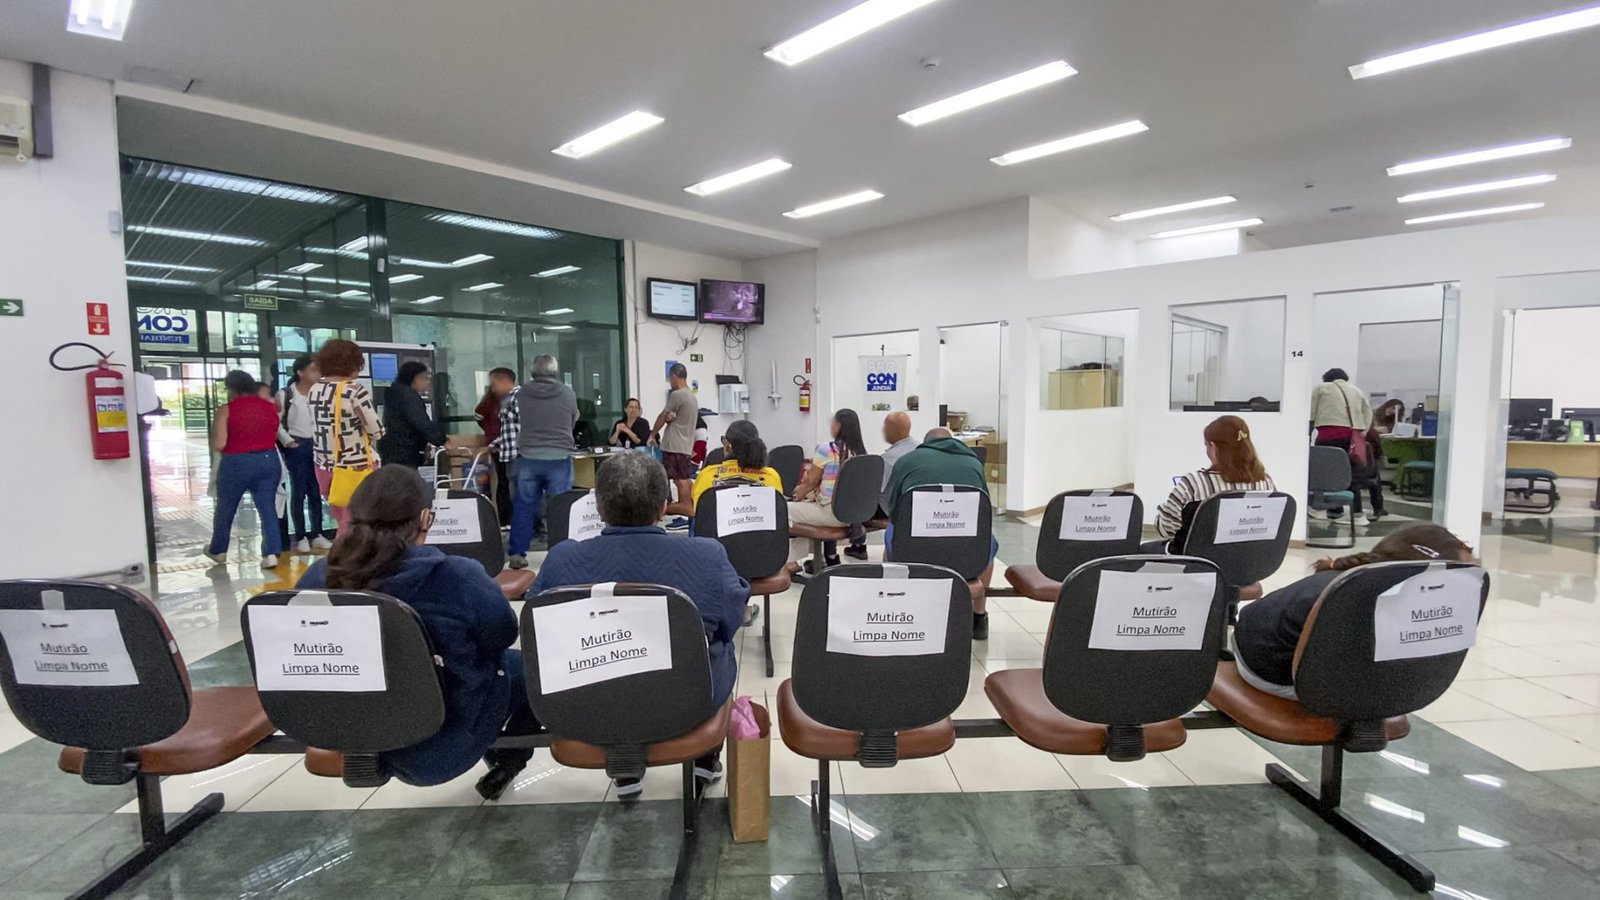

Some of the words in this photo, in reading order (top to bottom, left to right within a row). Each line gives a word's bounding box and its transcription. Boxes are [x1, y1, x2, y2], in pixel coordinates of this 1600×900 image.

[1291, 350, 1303, 358] 14
[867, 373, 897, 384] CON
[866, 612, 914, 622] Mutirão
[1132, 606, 1177, 617] Mutirão
[1411, 605, 1453, 620] Mutirão
[1117, 624, 1151, 635] Limpa
[1153, 624, 1186, 634] Nome
[1400, 629, 1432, 642] Limpa
[1434, 624, 1463, 637] Nome
[581, 629, 632, 648] Mutirão
[853, 630, 888, 641] Limpa
[891, 630, 925, 640] Nome
[40, 643, 88, 654] Mutirão
[293, 643, 343, 654] Mutirão
[568, 655, 607, 671] Limpa
[610, 647, 648, 660] Nome
[34, 660, 68, 671] Limpa
[71, 661, 108, 671] Nome
[282, 663, 319, 674] Limpa
[323, 663, 359, 674] Nome
